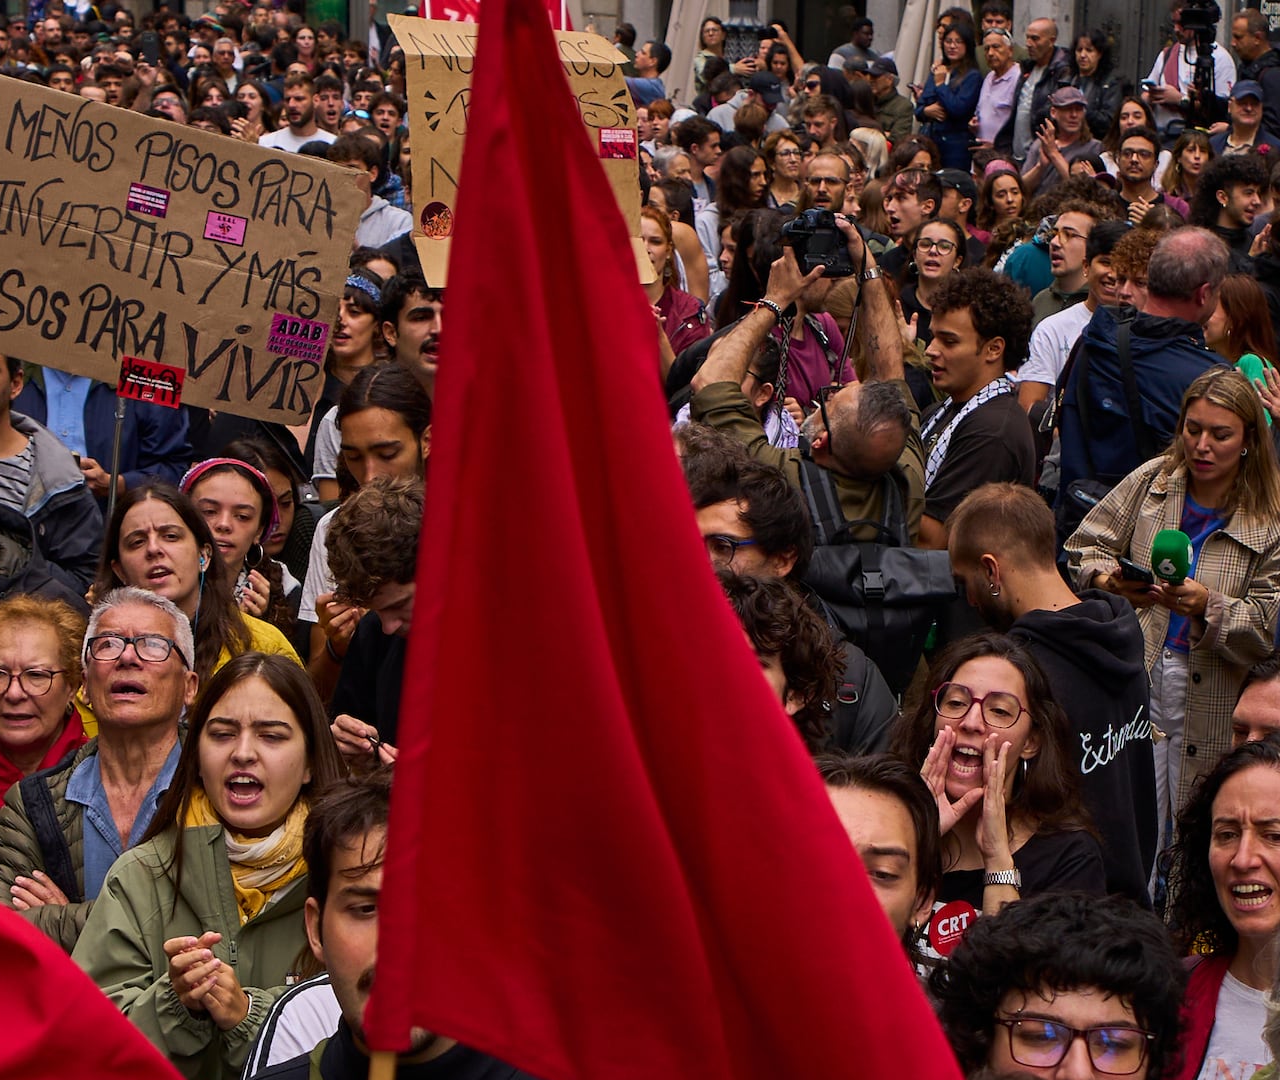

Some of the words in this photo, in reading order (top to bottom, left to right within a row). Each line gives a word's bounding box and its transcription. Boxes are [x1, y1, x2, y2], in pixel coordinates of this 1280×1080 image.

[5, 99, 118, 172] MENOS
[136, 131, 240, 208] PISOS
[249, 159, 338, 240] PARA
[198, 243, 246, 305] Y
[241, 251, 322, 319] MÁS
[74, 283, 167, 362] PARA
[277, 319, 324, 341] ADAB
[1080, 704, 1153, 775] Extremadu
[938, 911, 970, 936] CRT
